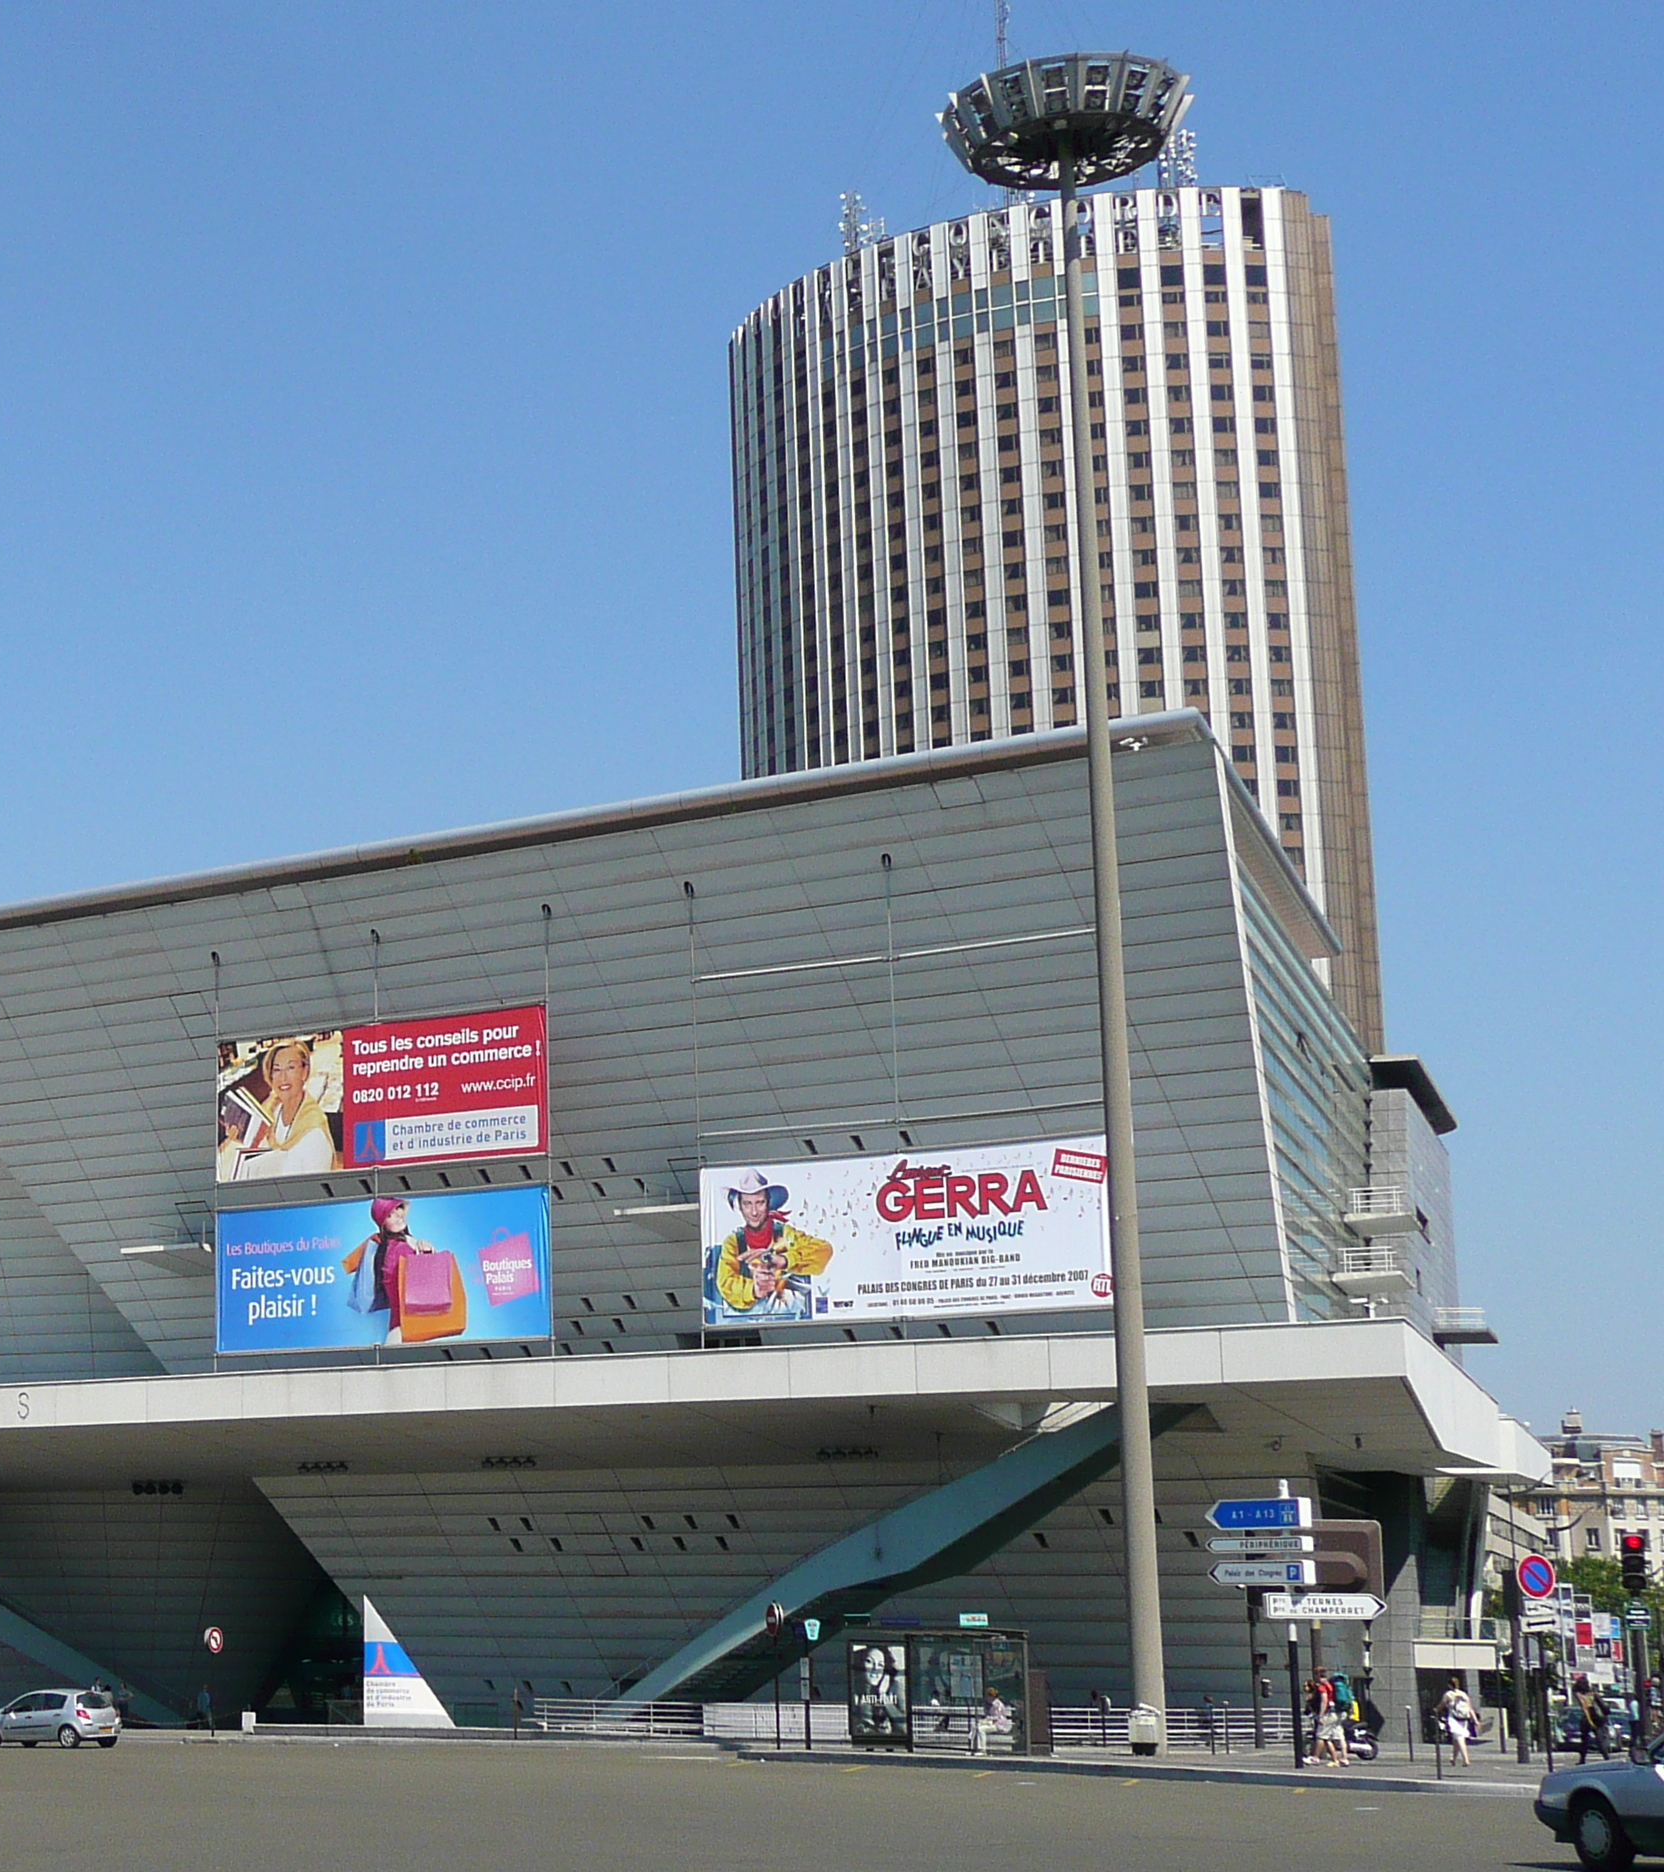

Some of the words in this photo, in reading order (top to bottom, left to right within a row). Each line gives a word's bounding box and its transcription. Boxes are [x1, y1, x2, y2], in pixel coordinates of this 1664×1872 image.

[352, 1039, 387, 1055] Tous
[391, 1035, 413, 1051] les
[416, 1027, 479, 1049] conseils
[483, 1025, 519, 1045] pour
[353, 1054, 424, 1078] reprendre
[428, 1053, 447, 1068] un
[451, 1044, 532, 1064] commerce
[536, 1040, 541, 1056] !
[353, 1088, 383, 1104] 0820
[387, 1085, 411, 1100] 012
[415, 1082, 439, 1097] 112
[461, 1072, 536, 1094] www.ccip.fr
[392, 1121, 444, 1136] Chambre
[447, 1118, 461, 1130] de
[465, 1114, 526, 1129] commerce
[392, 1139, 403, 1151] et
[476, 1130, 490, 1143] de
[494, 1128, 527, 1141] Paris
[876, 1169, 1048, 1223] GERRA
[226, 1243, 242, 1256] Les
[244, 1239, 294, 1256] Boutiques
[296, 1236, 310, 1251] du
[312, 1235, 342, 1250] Palais
[895, 1225, 945, 1250] FLINGUE
[948, 1222, 962, 1237] EN
[965, 1219, 1025, 1244] MUSIQUE
[483, 1257, 532, 1273] Boutiques
[232, 1265, 335, 1290] Faites-vous
[486, 1270, 514, 1285] Palais
[858, 1283, 883, 1295] PALAIS
[885, 1281, 899, 1293] DES
[939, 1279, 948, 1290] DE
[951, 1277, 974, 1289] PARIS
[977, 1277, 987, 1288] du
[988, 1276, 998, 1287] 27
[999, 1276, 1010, 1286] au
[1011, 1274, 1021, 1285] 31
[1023, 1271, 1066, 1284] décembre
[1068, 1270, 1088, 1281] 2007
[248, 1294, 305, 1326] plaisir
[311, 1294, 317, 1316] !
[1302, 1607, 1365, 1615] CHAMPERRET
